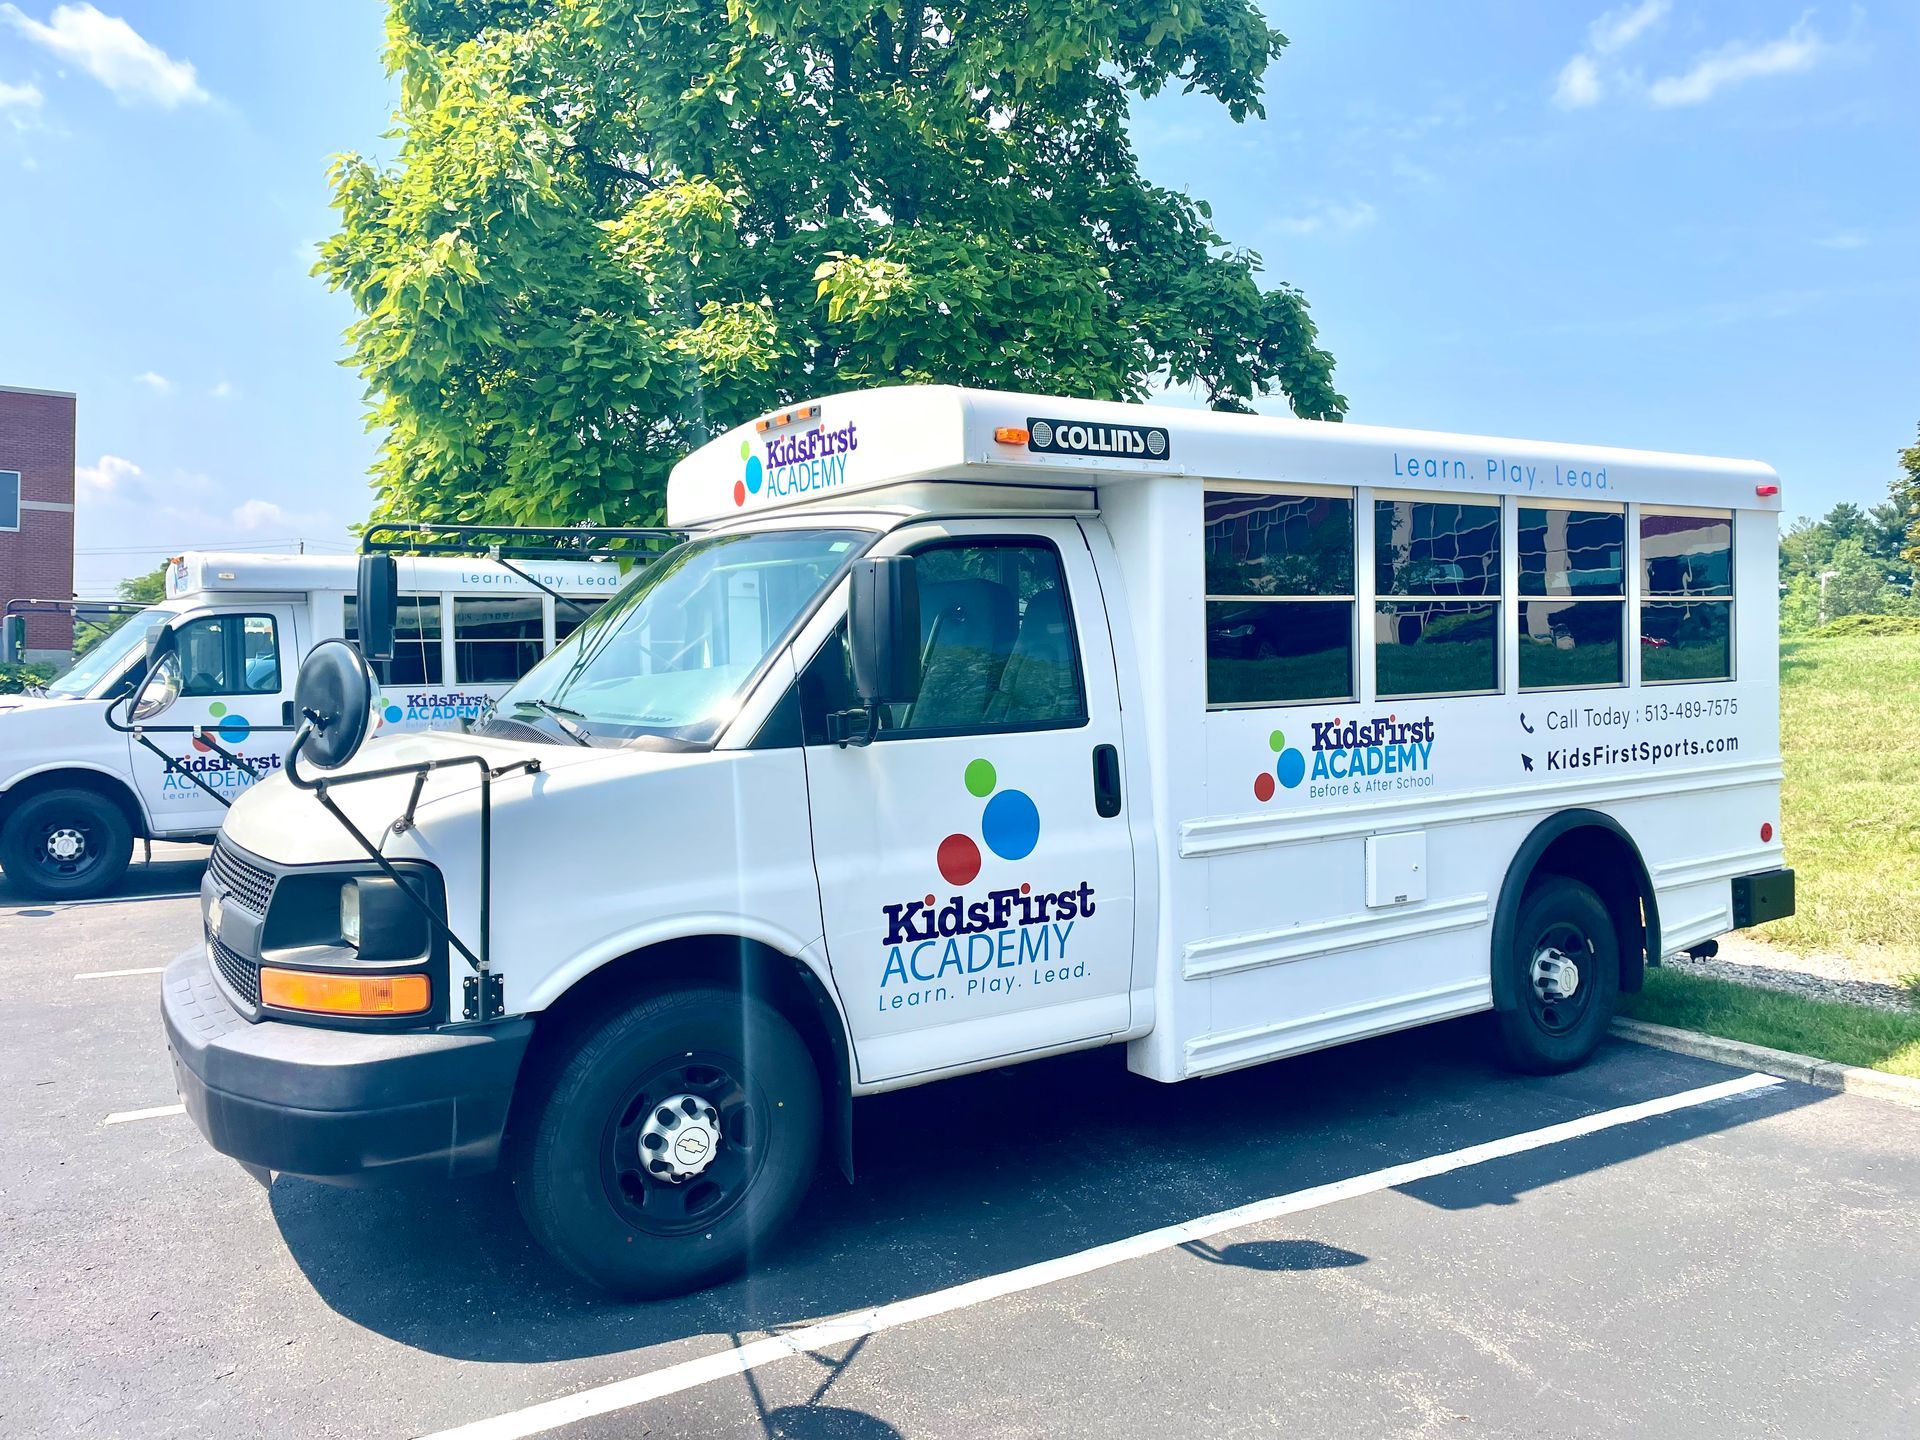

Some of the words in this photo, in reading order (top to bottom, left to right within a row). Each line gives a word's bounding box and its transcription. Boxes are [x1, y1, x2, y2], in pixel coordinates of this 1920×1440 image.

[766, 421, 858, 470] KidsFirst
[1055, 425, 1145, 453] COLLINS
[767, 453, 847, 498] ACADEMY
[1394, 453, 1474, 480] Learn.
[1487, 459, 1544, 490] Play.
[1556, 465, 1614, 490] Lead.
[461, 572, 518, 584] Learn.
[578, 575, 622, 586] Lead.
[1311, 714, 1434, 751] KidsFirst
[1546, 709, 1578, 730] Call
[1584, 706, 1630, 729] Today
[1645, 698, 1738, 722] 513-489-7575
[1311, 742, 1432, 780] ACADEMY
[1547, 736, 1738, 770] KidsFirstSports.com
[1310, 783, 1349, 798] Before
[1353, 781, 1361, 794] &
[1365, 778, 1393, 792] After
[1396, 774, 1434, 789] School
[882, 881, 1096, 946] KidsFirst
[880, 921, 1074, 987] ACADEMY
[879, 987, 954, 1011] Learn.
[967, 976, 1022, 995] Play.
[1034, 961, 1091, 984] Lead.
